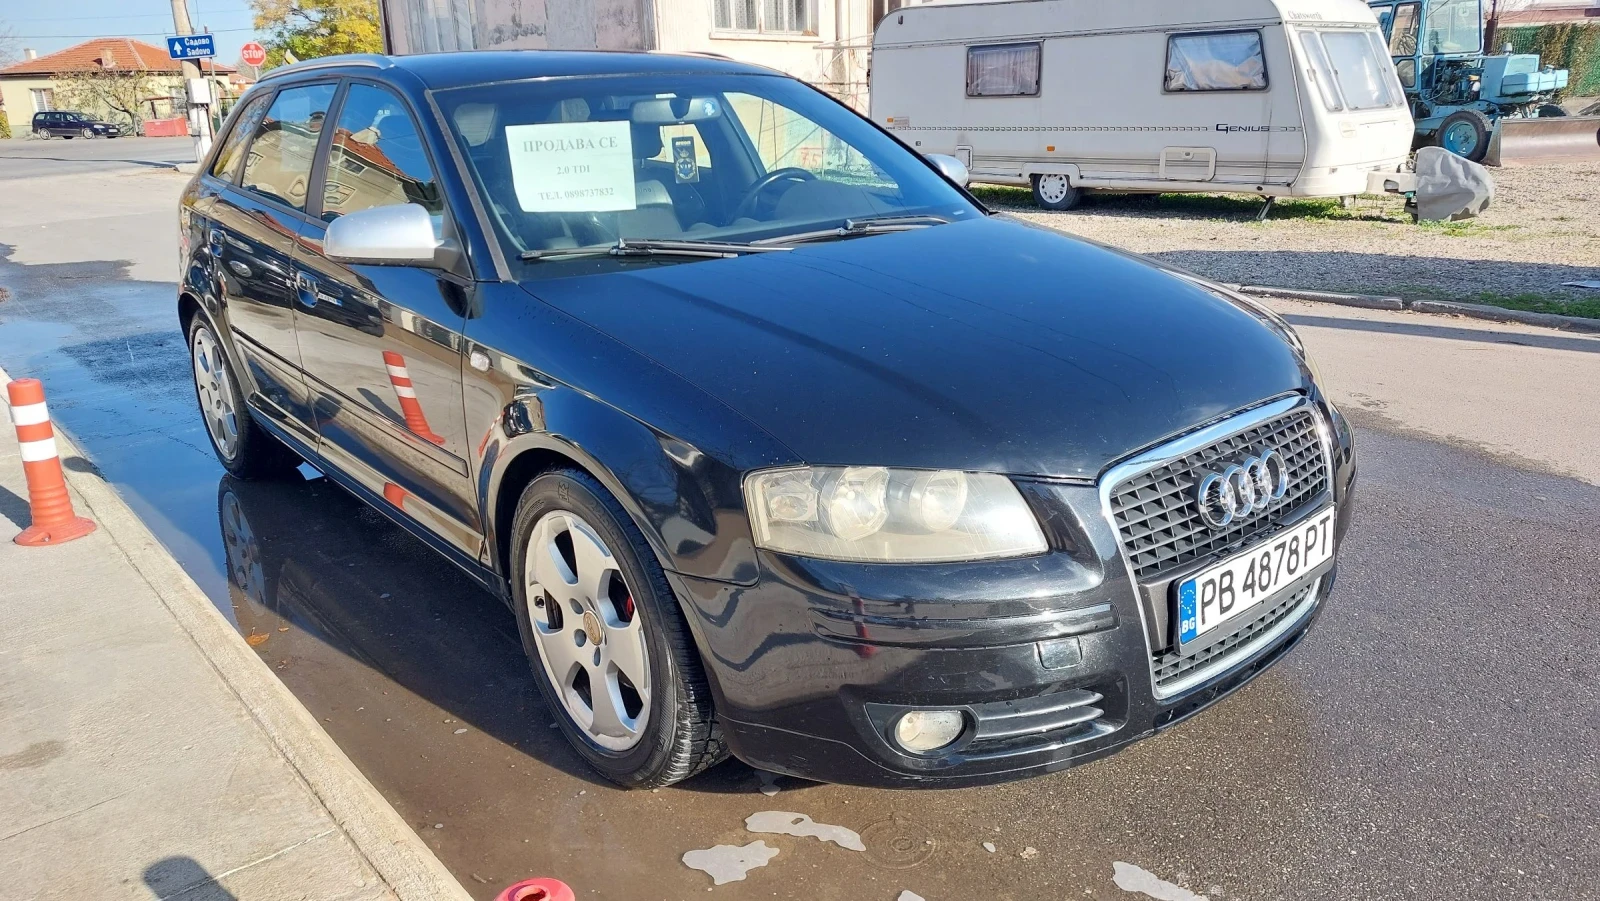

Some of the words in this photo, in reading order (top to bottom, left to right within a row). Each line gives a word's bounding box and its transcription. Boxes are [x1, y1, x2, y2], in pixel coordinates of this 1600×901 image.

[185, 37, 210, 46] Садово
[187, 48, 211, 56] Sadovo
[243, 50, 263, 59] STOP
[523, 137, 595, 153] ПРОДАВА
[598, 136, 618, 149] СЕ
[556, 166, 570, 175] 2.0
[573, 165, 591, 174] TDI
[537, 191, 562, 201] ТЕЛ.
[564, 187, 614, 199] 0898737832
[1200, 569, 1236, 626] PB
[1242, 535, 1300, 599] 4878
[1303, 515, 1331, 567] PT
[1181, 618, 1195, 634] BG
